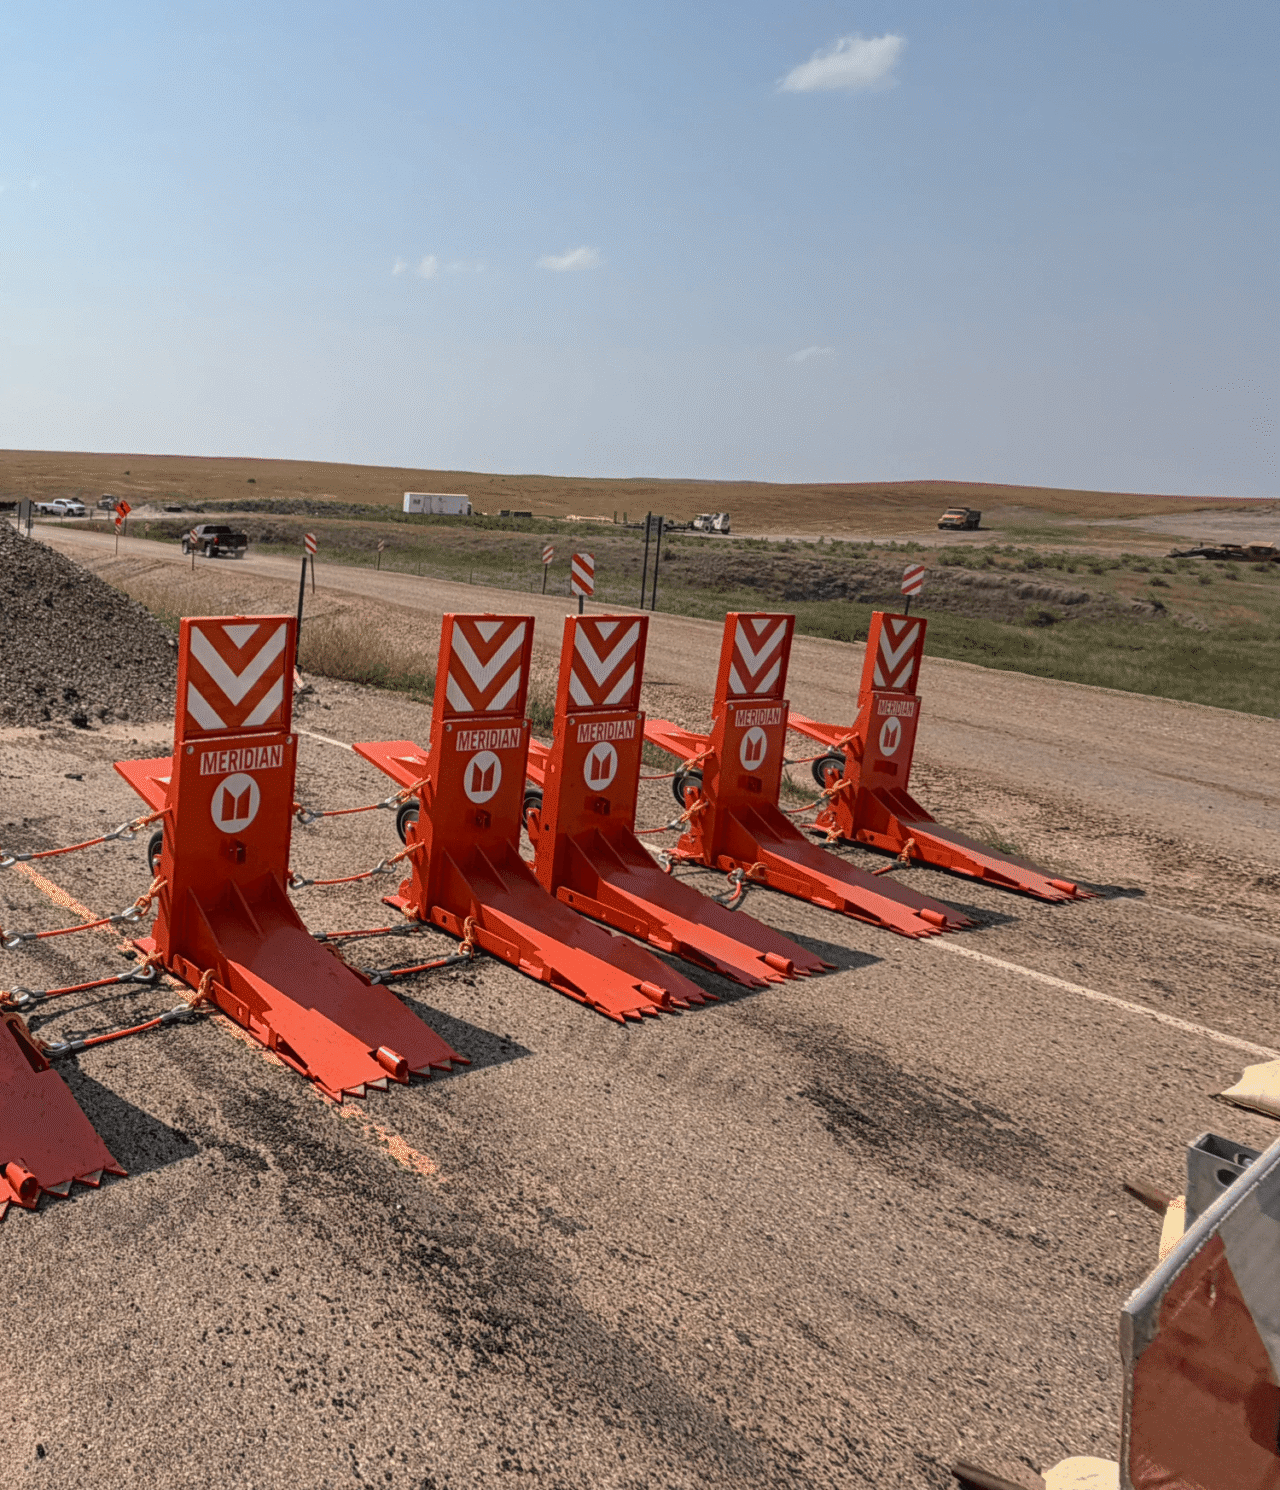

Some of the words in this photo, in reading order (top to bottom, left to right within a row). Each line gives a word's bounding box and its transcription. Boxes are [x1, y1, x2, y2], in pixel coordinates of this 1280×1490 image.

[737, 709, 780, 725] MERIDIAN
[879, 701, 912, 715] MERIDIAN
[458, 730, 519, 749] MERIDIAN
[579, 721, 633, 741] MERIDIAN
[202, 746, 280, 774] MERIDIAN
